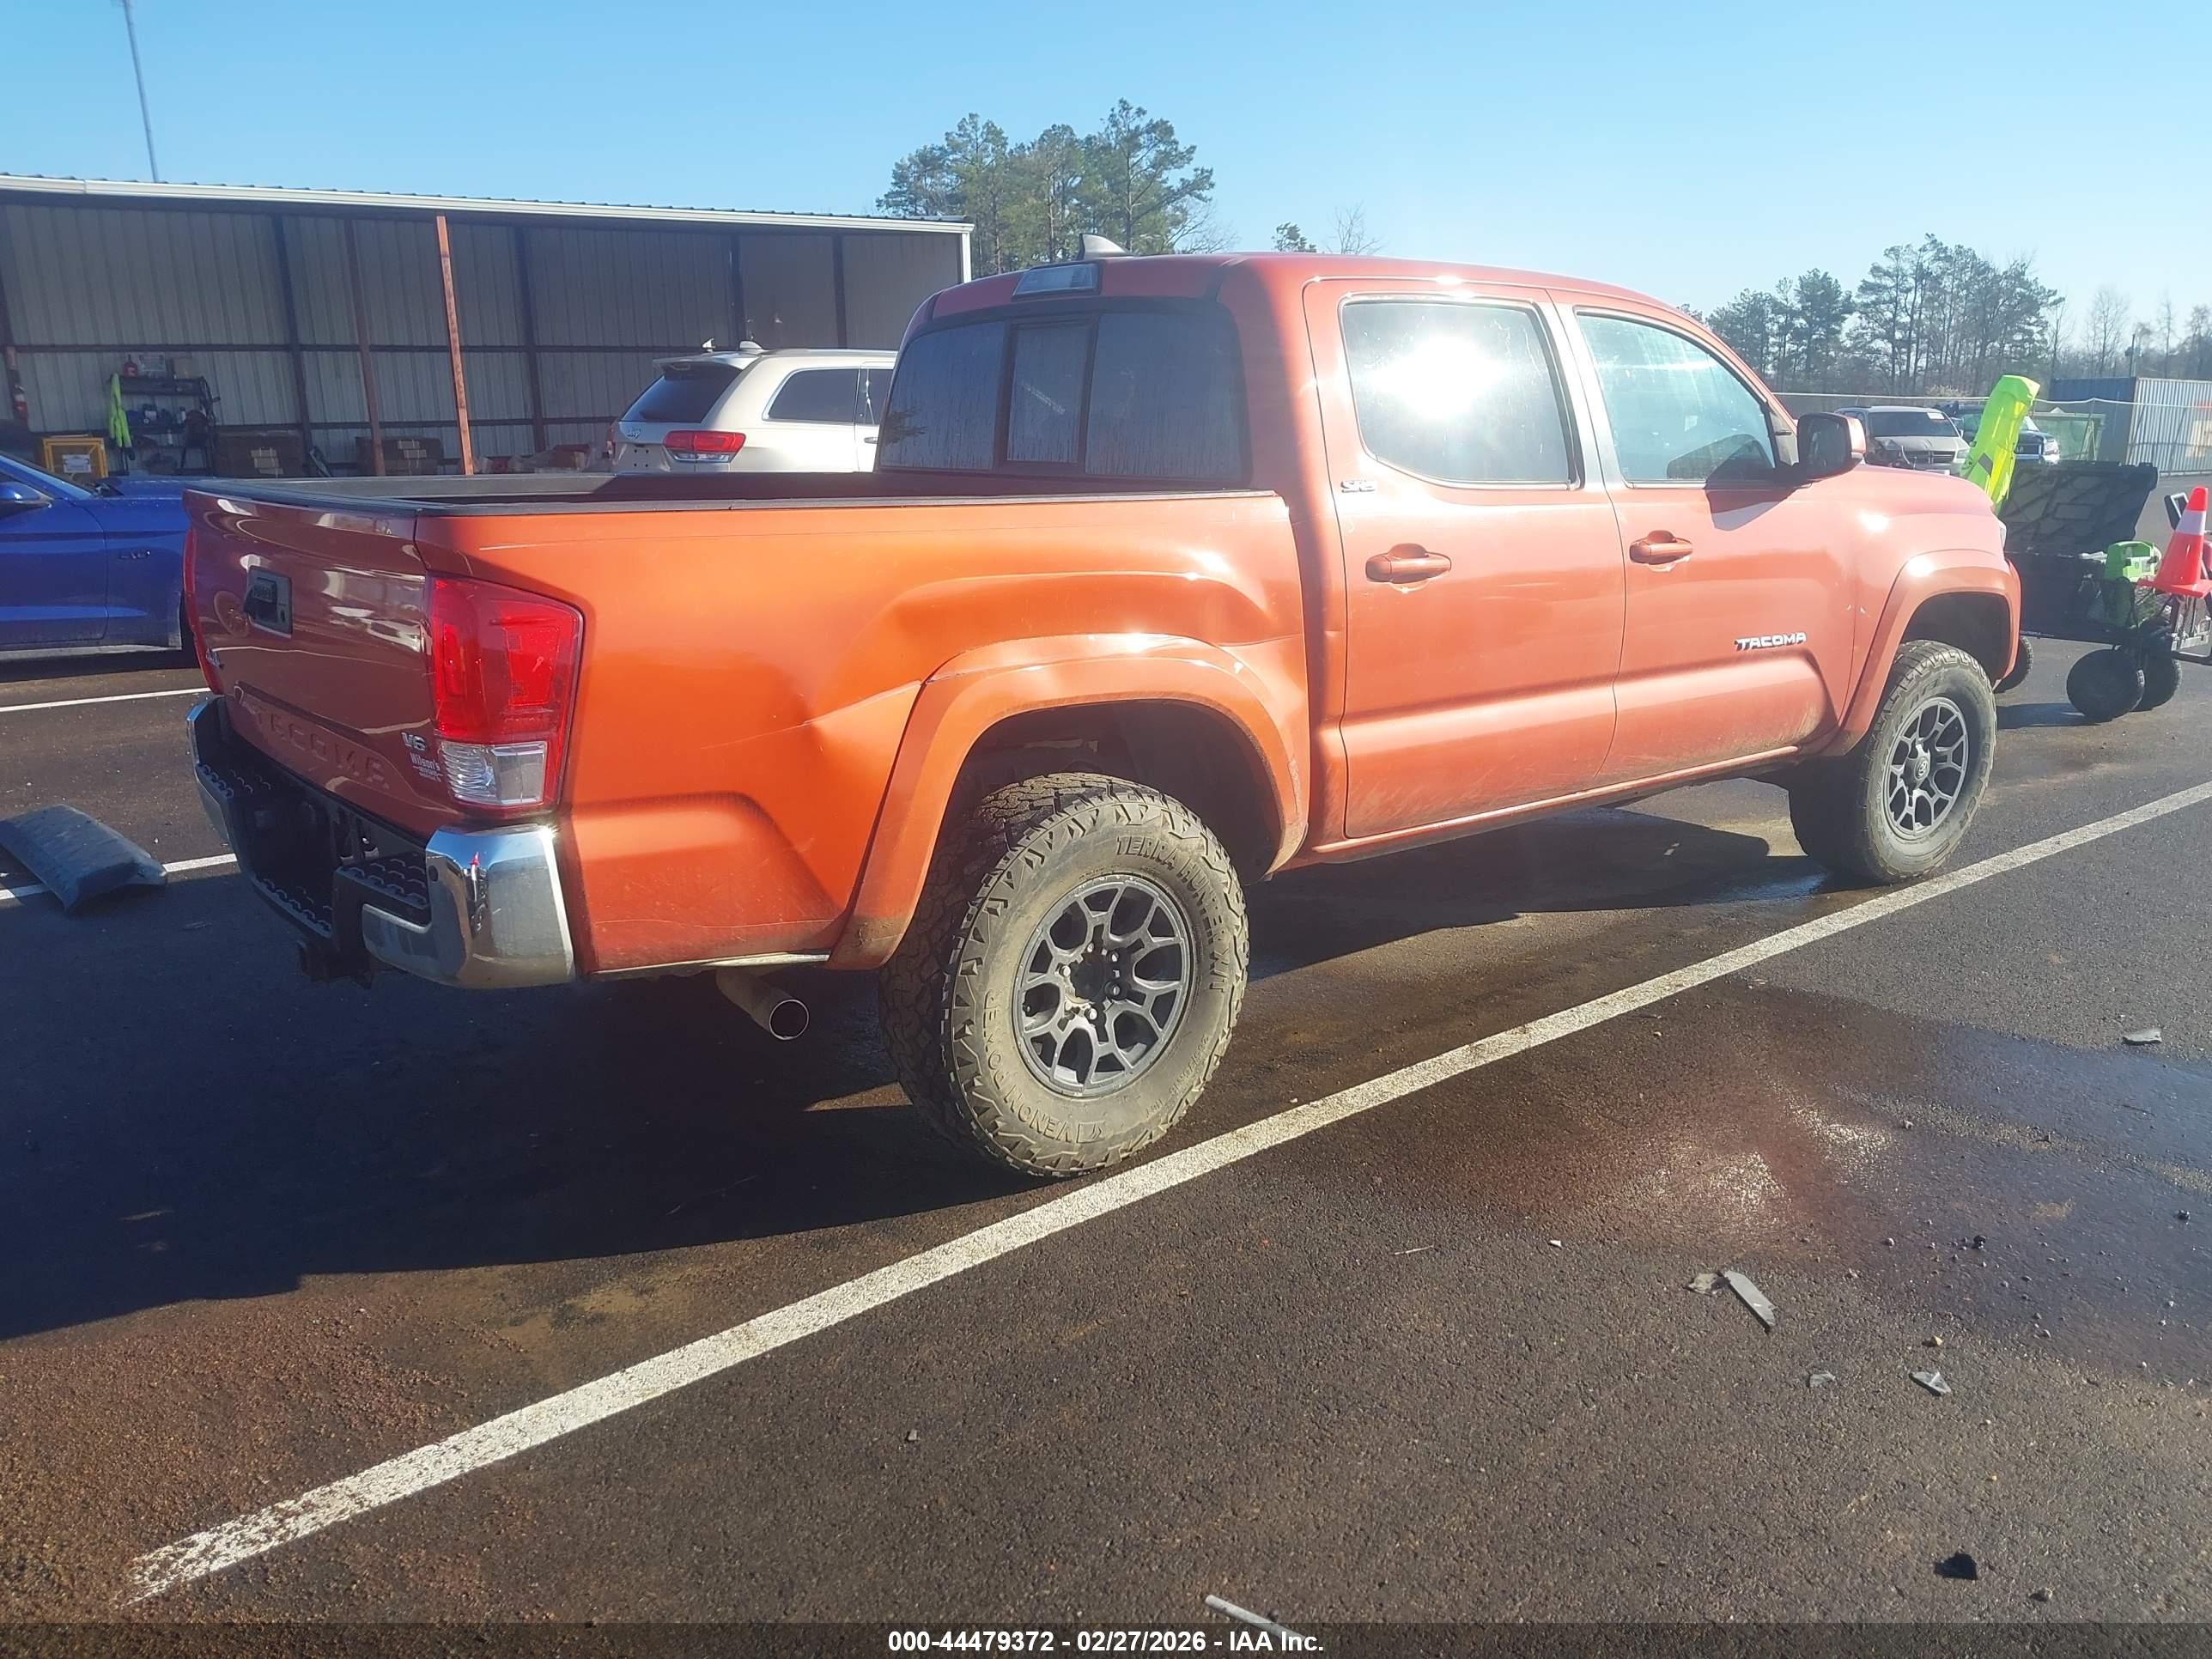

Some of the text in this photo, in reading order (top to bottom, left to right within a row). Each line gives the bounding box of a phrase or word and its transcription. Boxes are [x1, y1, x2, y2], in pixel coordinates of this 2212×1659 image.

[1734, 631, 1808, 651] TACOMA
[401, 732, 427, 751] V6
[1116, 836, 1229, 993] TERRA HUNTER X/T
[983, 990, 1073, 1144] VENOM POWER
